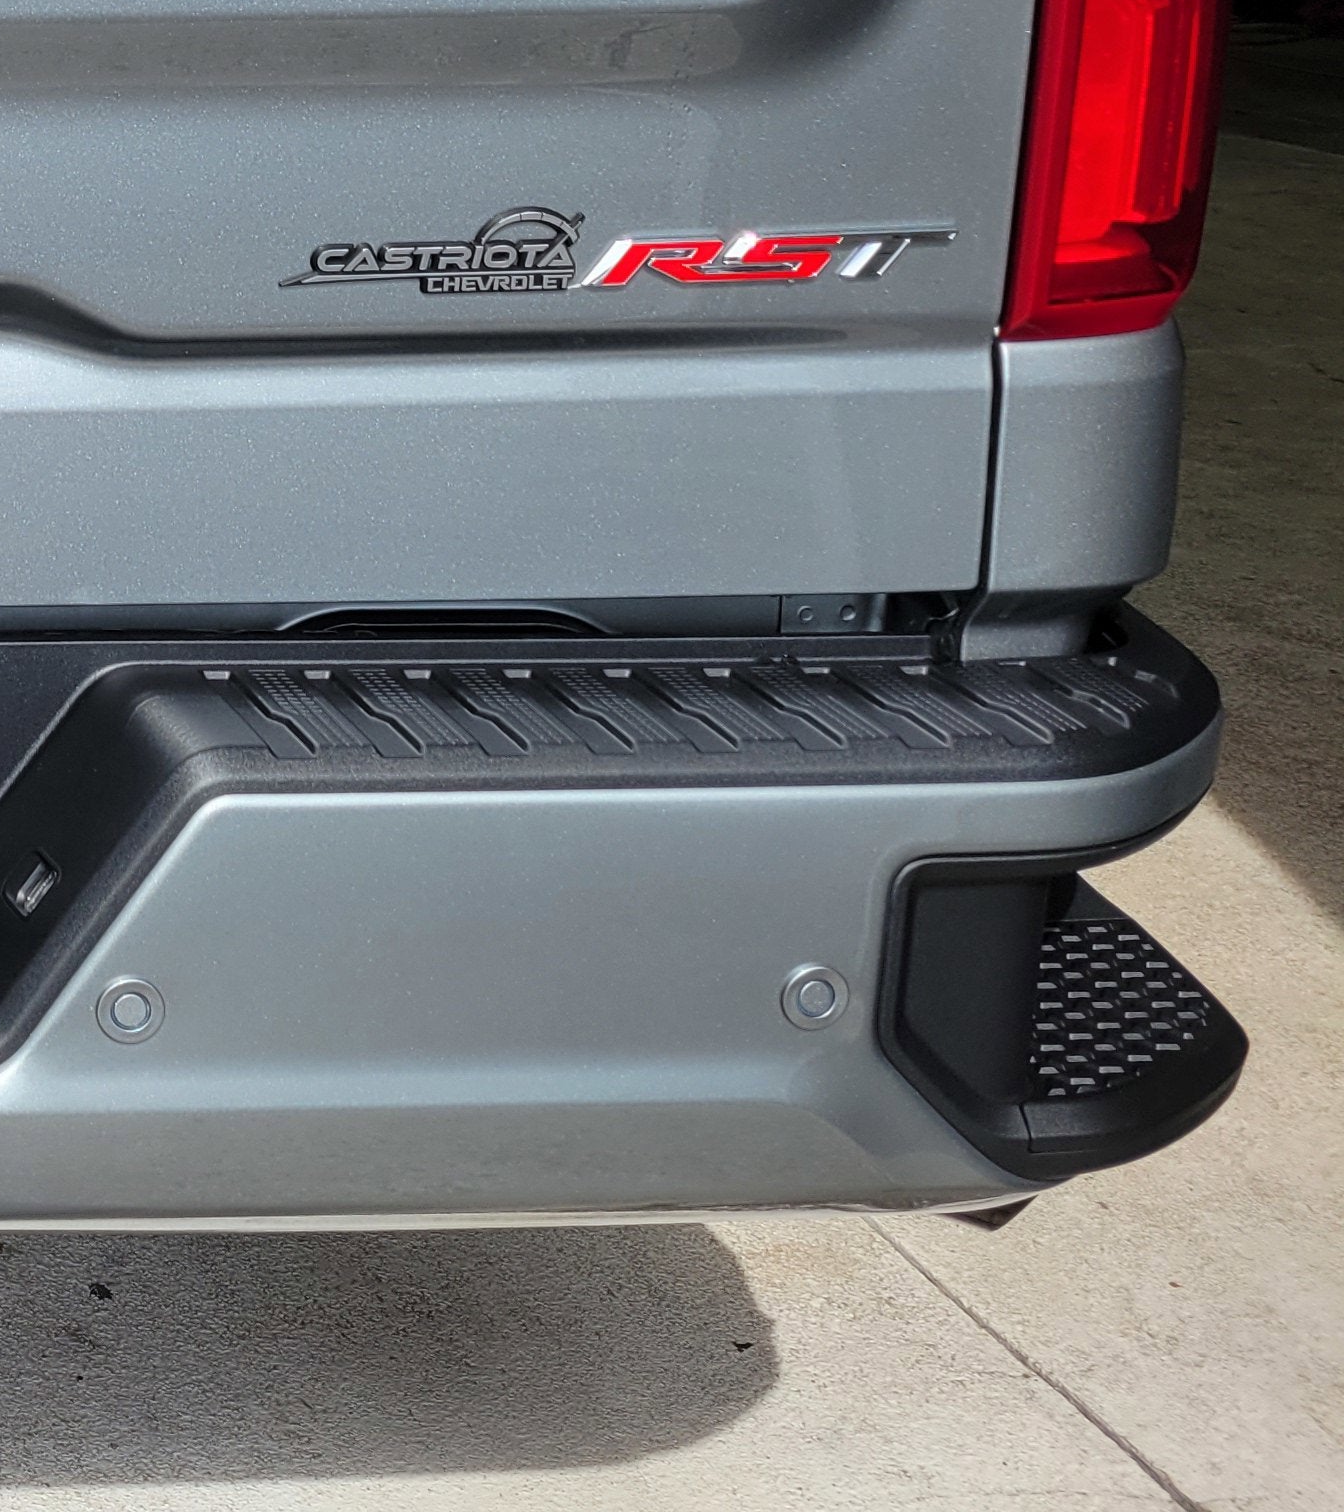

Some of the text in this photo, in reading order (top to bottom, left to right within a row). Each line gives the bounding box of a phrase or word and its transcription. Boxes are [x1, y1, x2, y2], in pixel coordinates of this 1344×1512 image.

[315, 240, 574, 272] CASTRIOTA
[581, 228, 958, 287] RST
[426, 275, 573, 292] CHEVROLET
